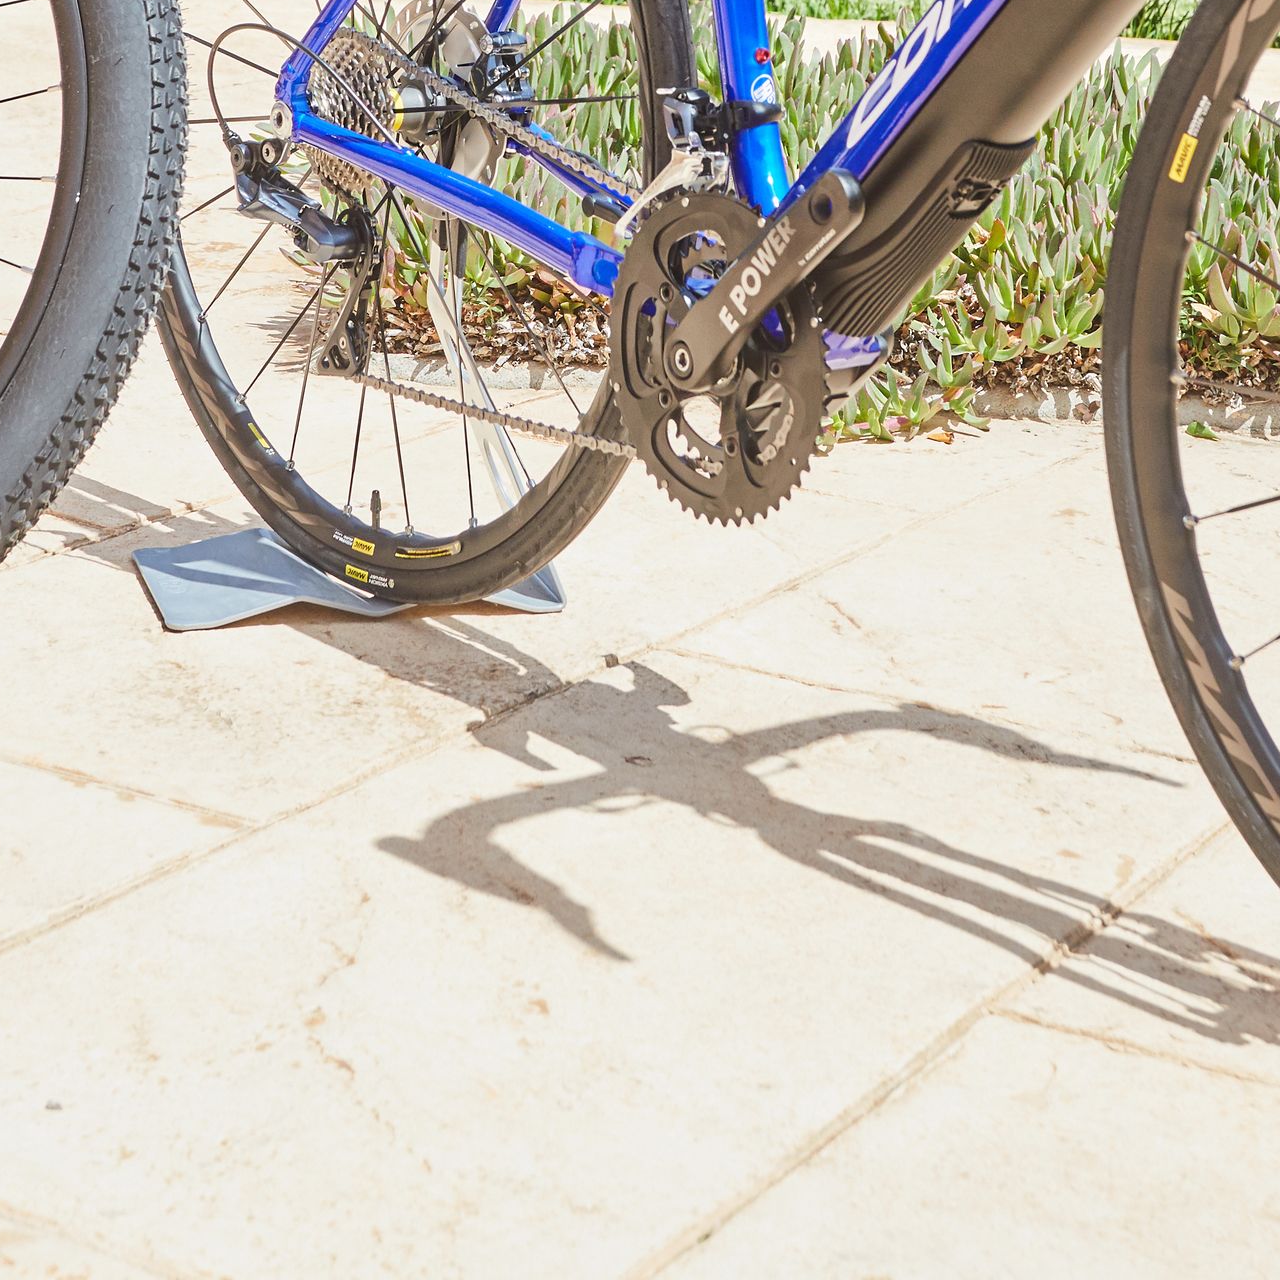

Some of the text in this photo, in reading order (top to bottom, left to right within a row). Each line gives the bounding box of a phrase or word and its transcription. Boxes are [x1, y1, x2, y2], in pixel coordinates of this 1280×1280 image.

[1175, 141, 1191, 176] MAVIC
[718, 215, 798, 335] E POWER
[354, 540, 373, 553] MAVIC
[347, 568, 367, 580] MAVIC
